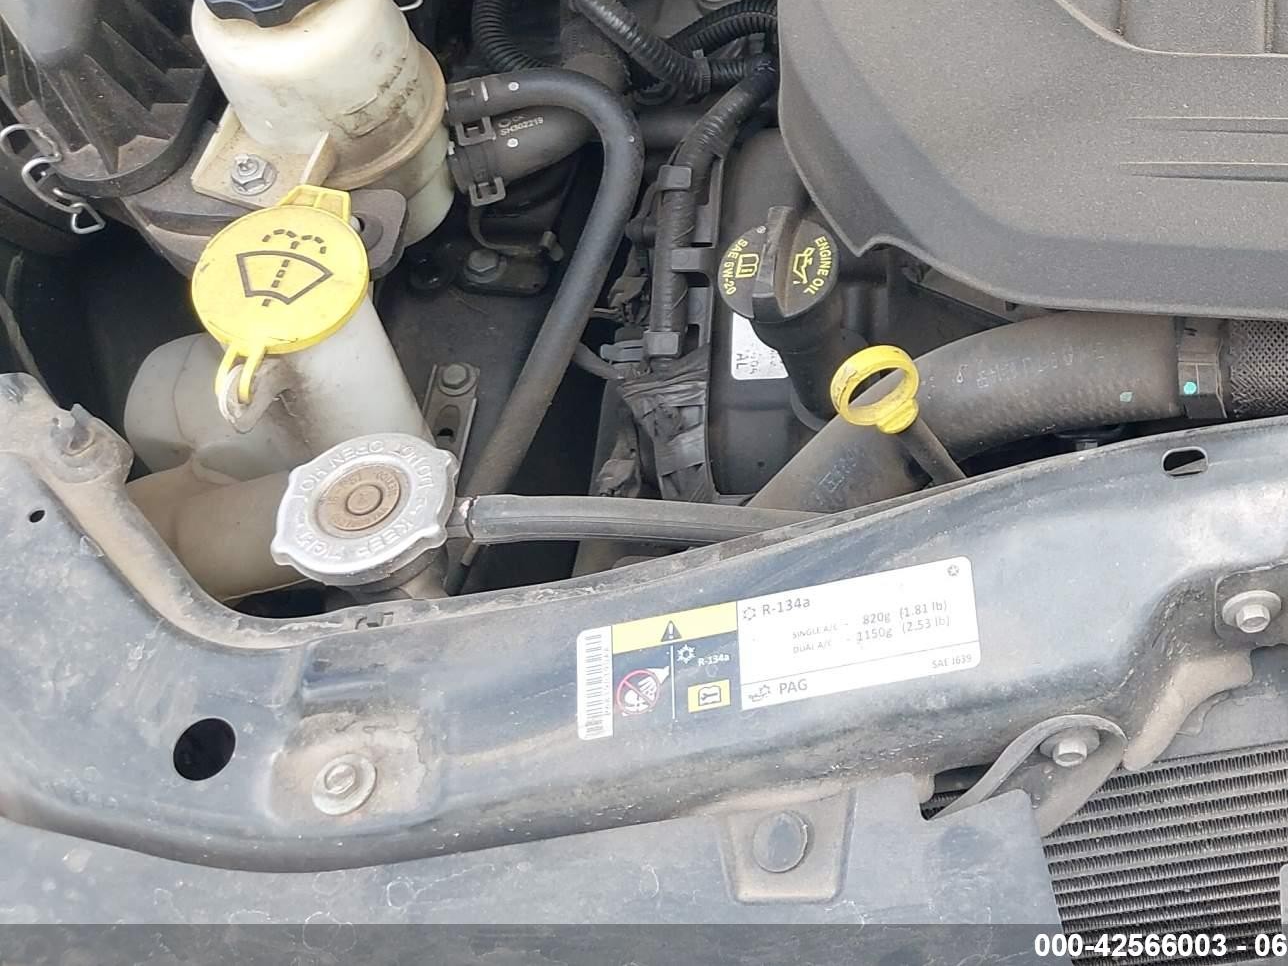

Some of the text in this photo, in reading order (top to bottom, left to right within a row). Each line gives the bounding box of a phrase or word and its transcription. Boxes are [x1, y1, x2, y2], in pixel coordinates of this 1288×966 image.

[727, 238, 748, 259] SAE
[803, 236, 833, 295] ENGINE OIL
[762, 597, 811, 616] R-134a
[792, 628, 820, 640] SINGLE
[863, 612, 891, 625] 820g
[899, 603, 928, 620] (1.81
[932, 600, 948, 612] lb)
[792, 644, 814, 655] DUAL
[857, 628, 893, 642] 1150g
[901, 618, 932, 635] (2.53
[697, 654, 730, 667] R-134a
[779, 678, 808, 695] PAG
